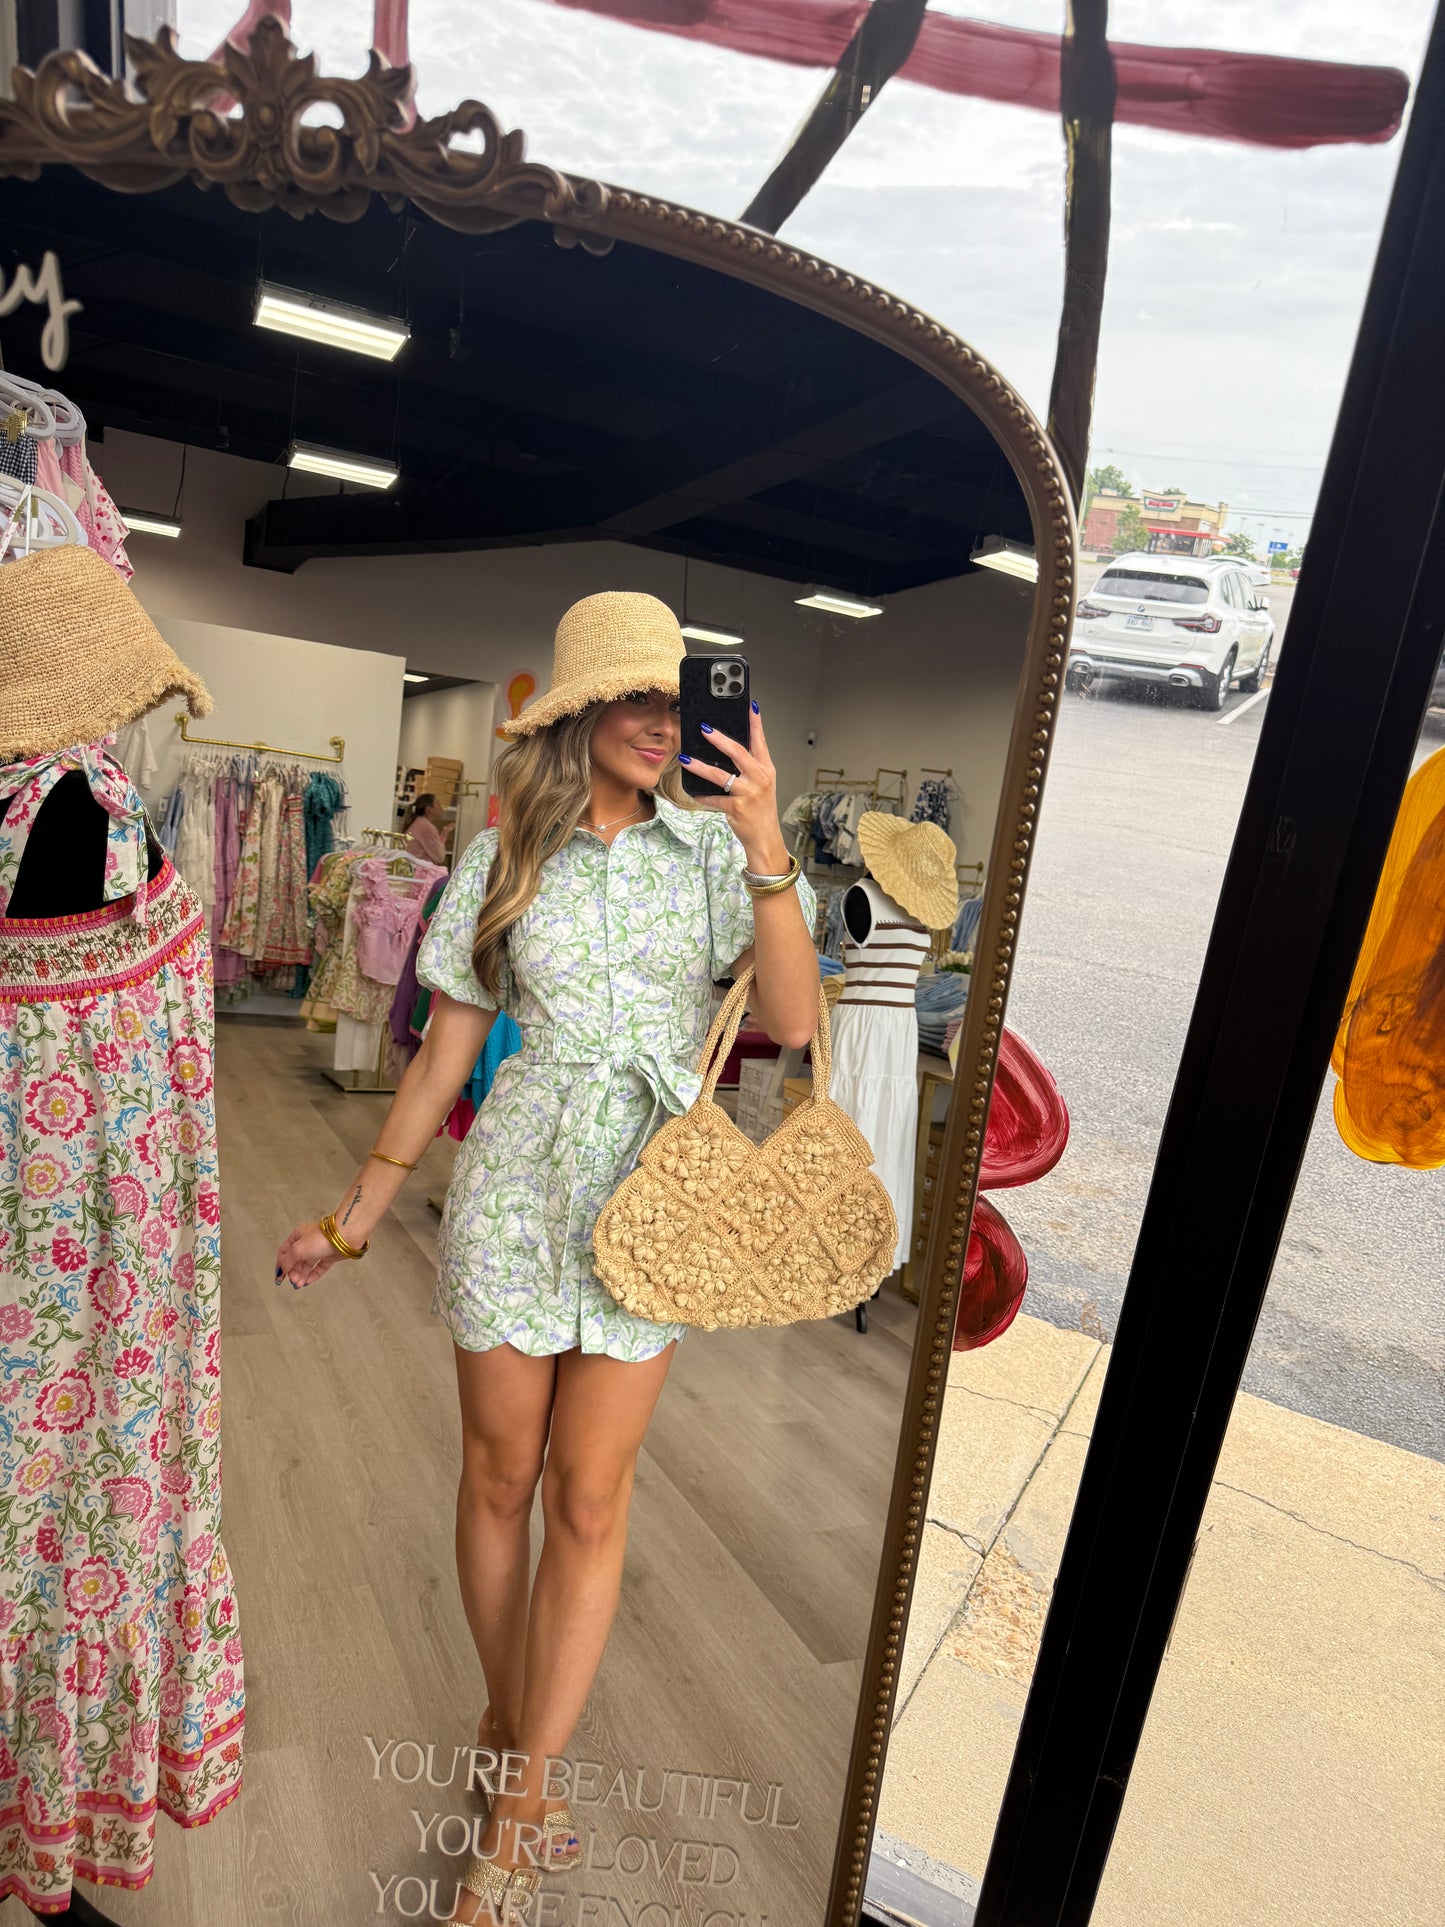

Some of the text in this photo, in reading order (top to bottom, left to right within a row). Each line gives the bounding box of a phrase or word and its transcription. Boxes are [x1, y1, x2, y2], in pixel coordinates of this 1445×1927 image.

[363, 1736, 800, 1830] YOU'RE BEAUTIFUL
[411, 1810, 740, 1887] YOU'RE LOVED
[369, 1871, 463, 1921] YOU
[471, 1884, 566, 1927] ARE
